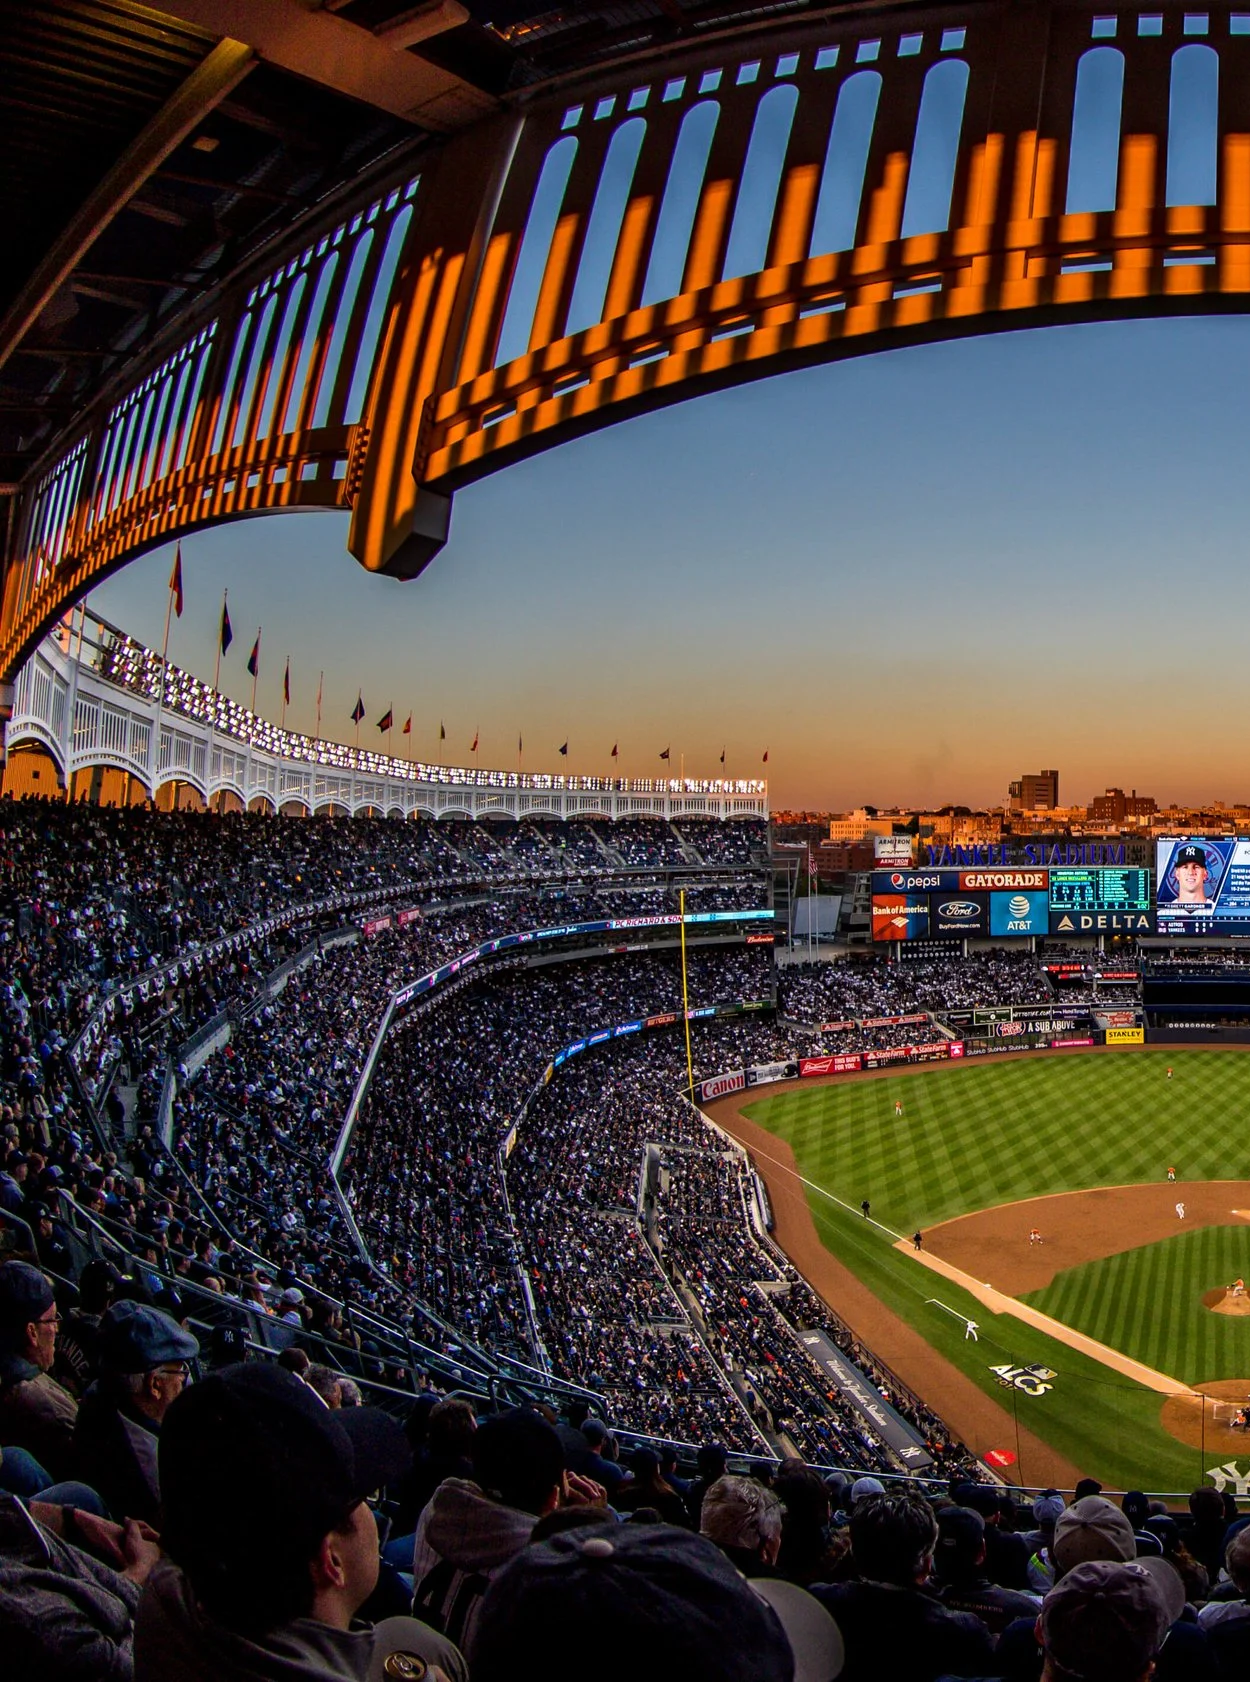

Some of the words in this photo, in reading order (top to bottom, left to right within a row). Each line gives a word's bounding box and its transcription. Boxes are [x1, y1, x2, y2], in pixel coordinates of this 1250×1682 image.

[926, 844, 1012, 866] YANKEE
[1024, 844, 1126, 866] STADIUM
[907, 874, 940, 889] pepsi
[964, 874, 1043, 888] GATORADE
[873, 906, 890, 914] Bank
[891, 906, 898, 914] of
[900, 905, 928, 914] America
[946, 904, 973, 916] Ford
[626, 918, 660, 926] RICHARD
[1007, 921, 1032, 930] AT&T
[1081, 915, 1149, 928] DELTA
[648, 1015, 675, 1026] RUTGERS
[1028, 1023, 1033, 1032] A
[1035, 1022, 1050, 1032] SUB
[1052, 1020, 1075, 1030] ABOVE
[703, 1075, 744, 1098] Canon
[988, 1364, 1054, 1396] ALCS
